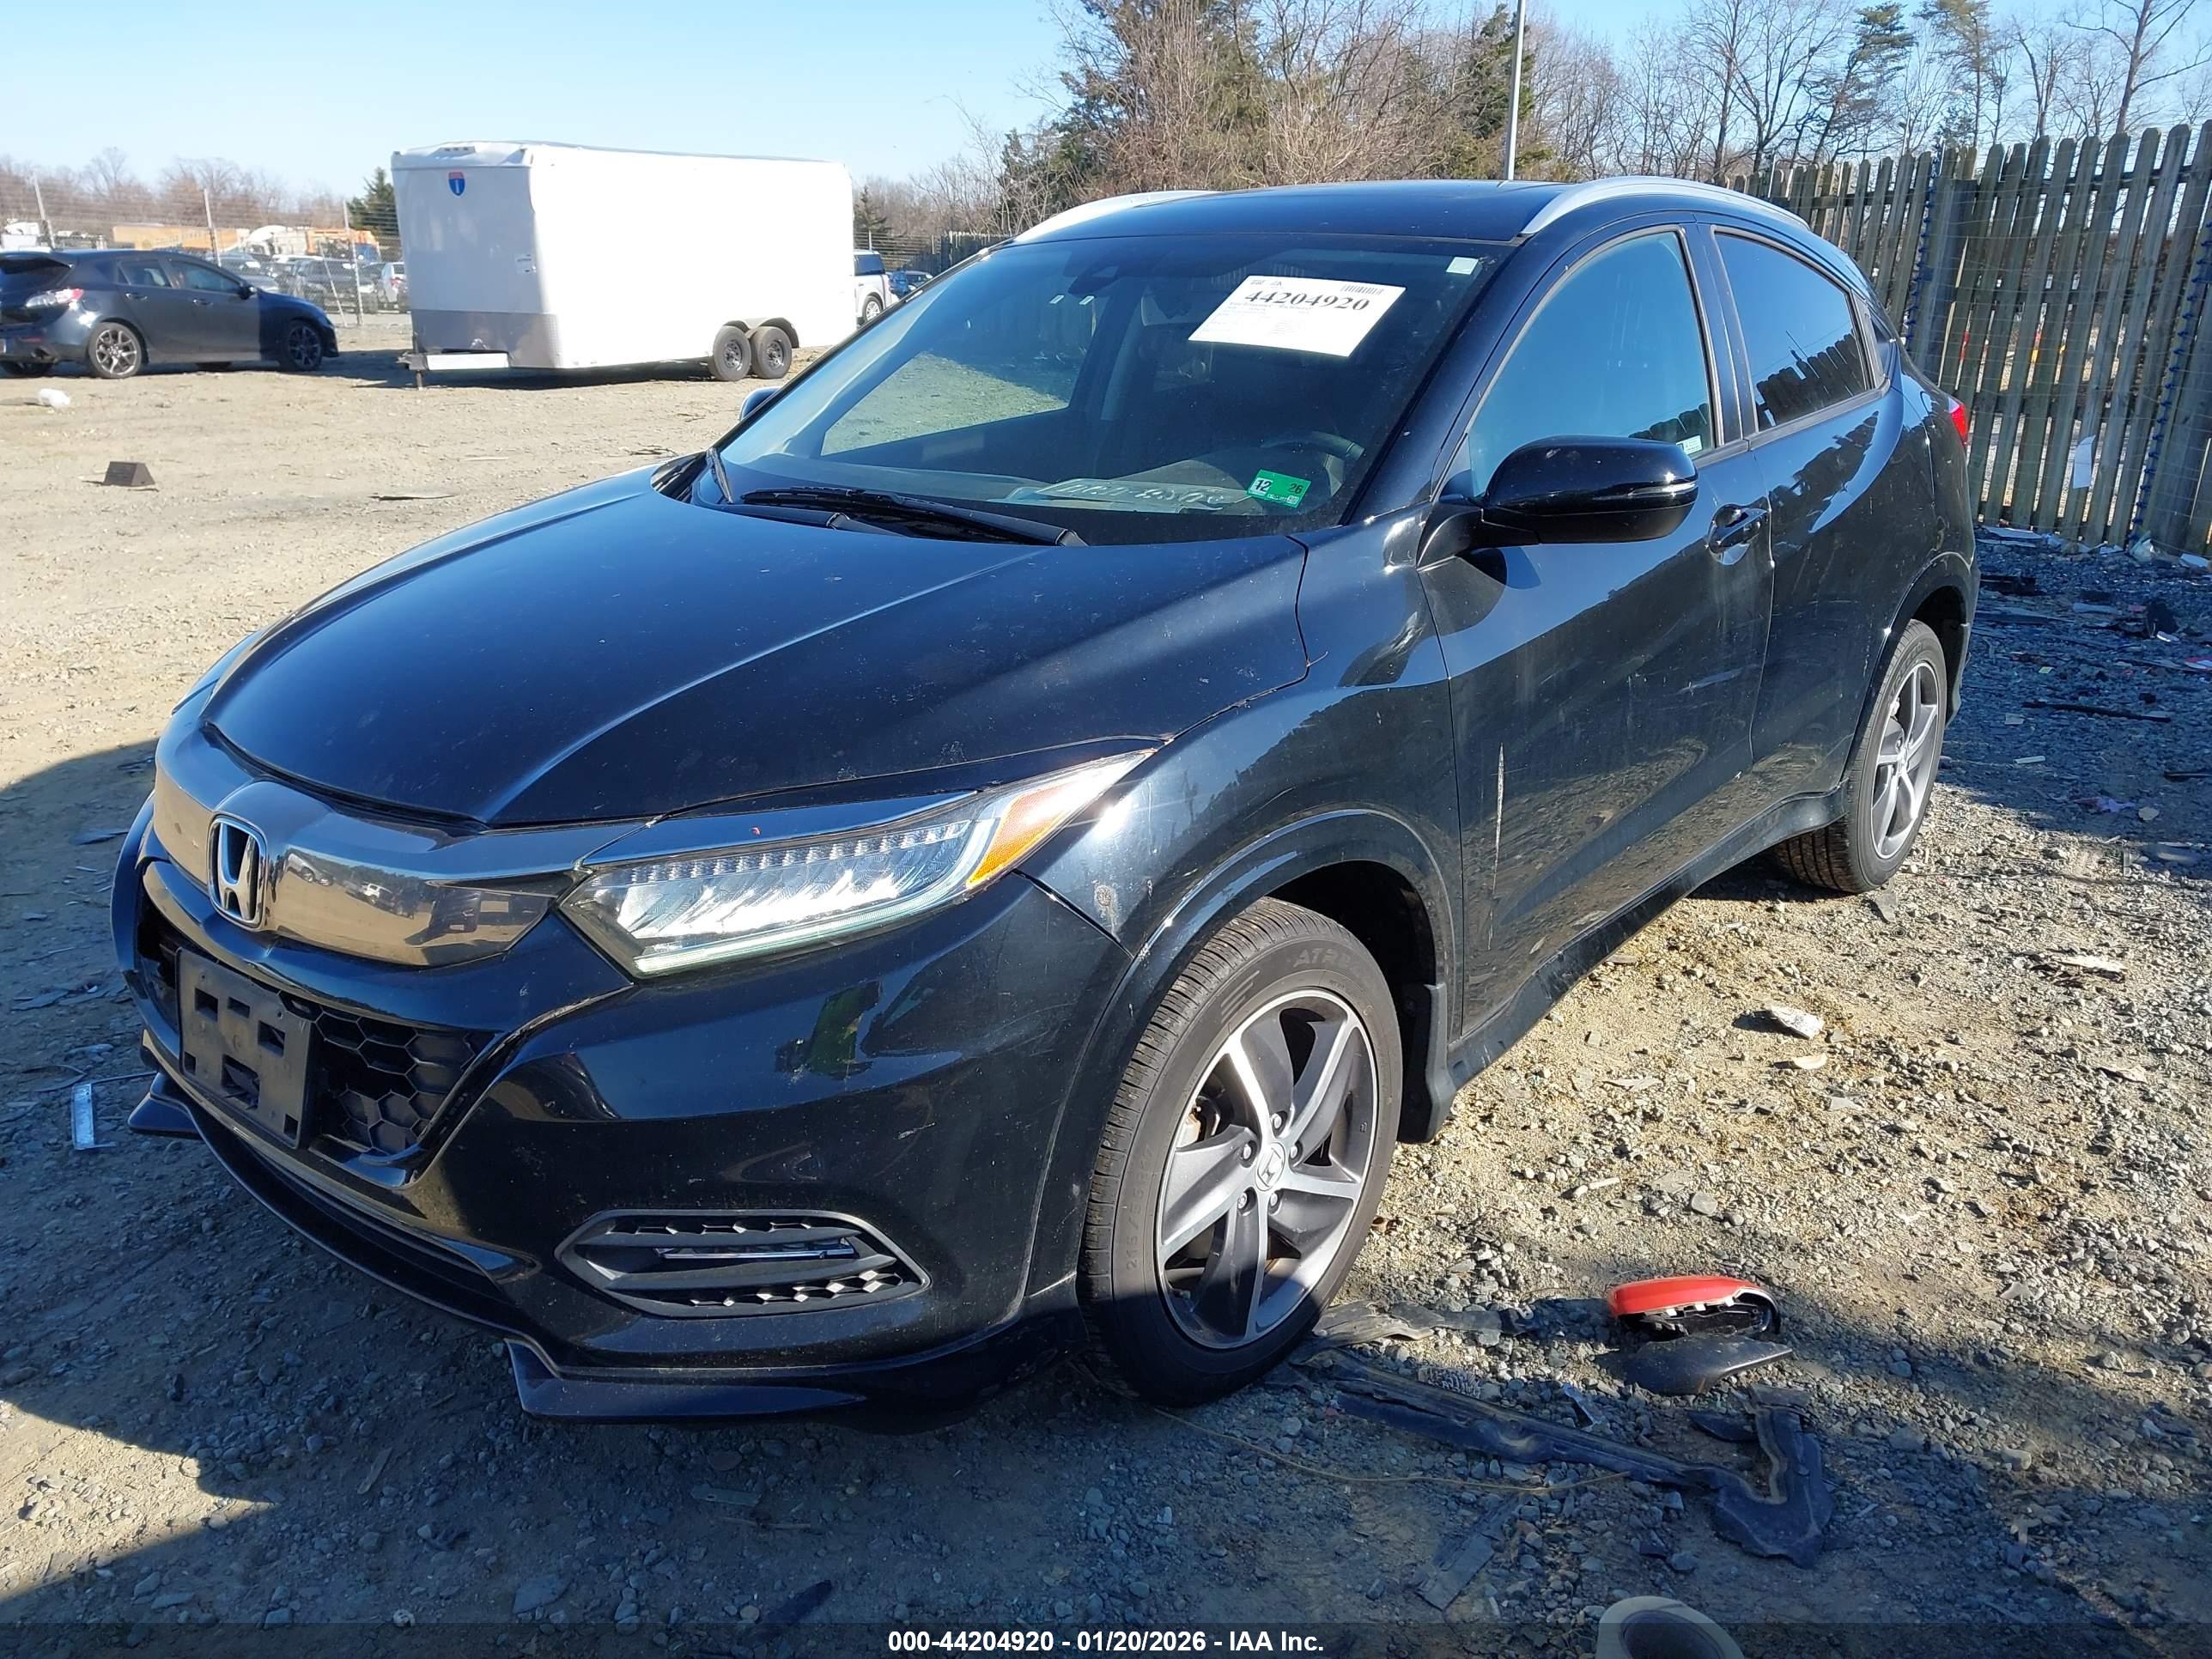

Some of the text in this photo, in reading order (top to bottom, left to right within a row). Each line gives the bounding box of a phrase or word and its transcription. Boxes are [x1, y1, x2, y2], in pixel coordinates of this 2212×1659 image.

[1244, 289, 1369, 311] 44204920
[1254, 479, 1304, 494] 12 26
